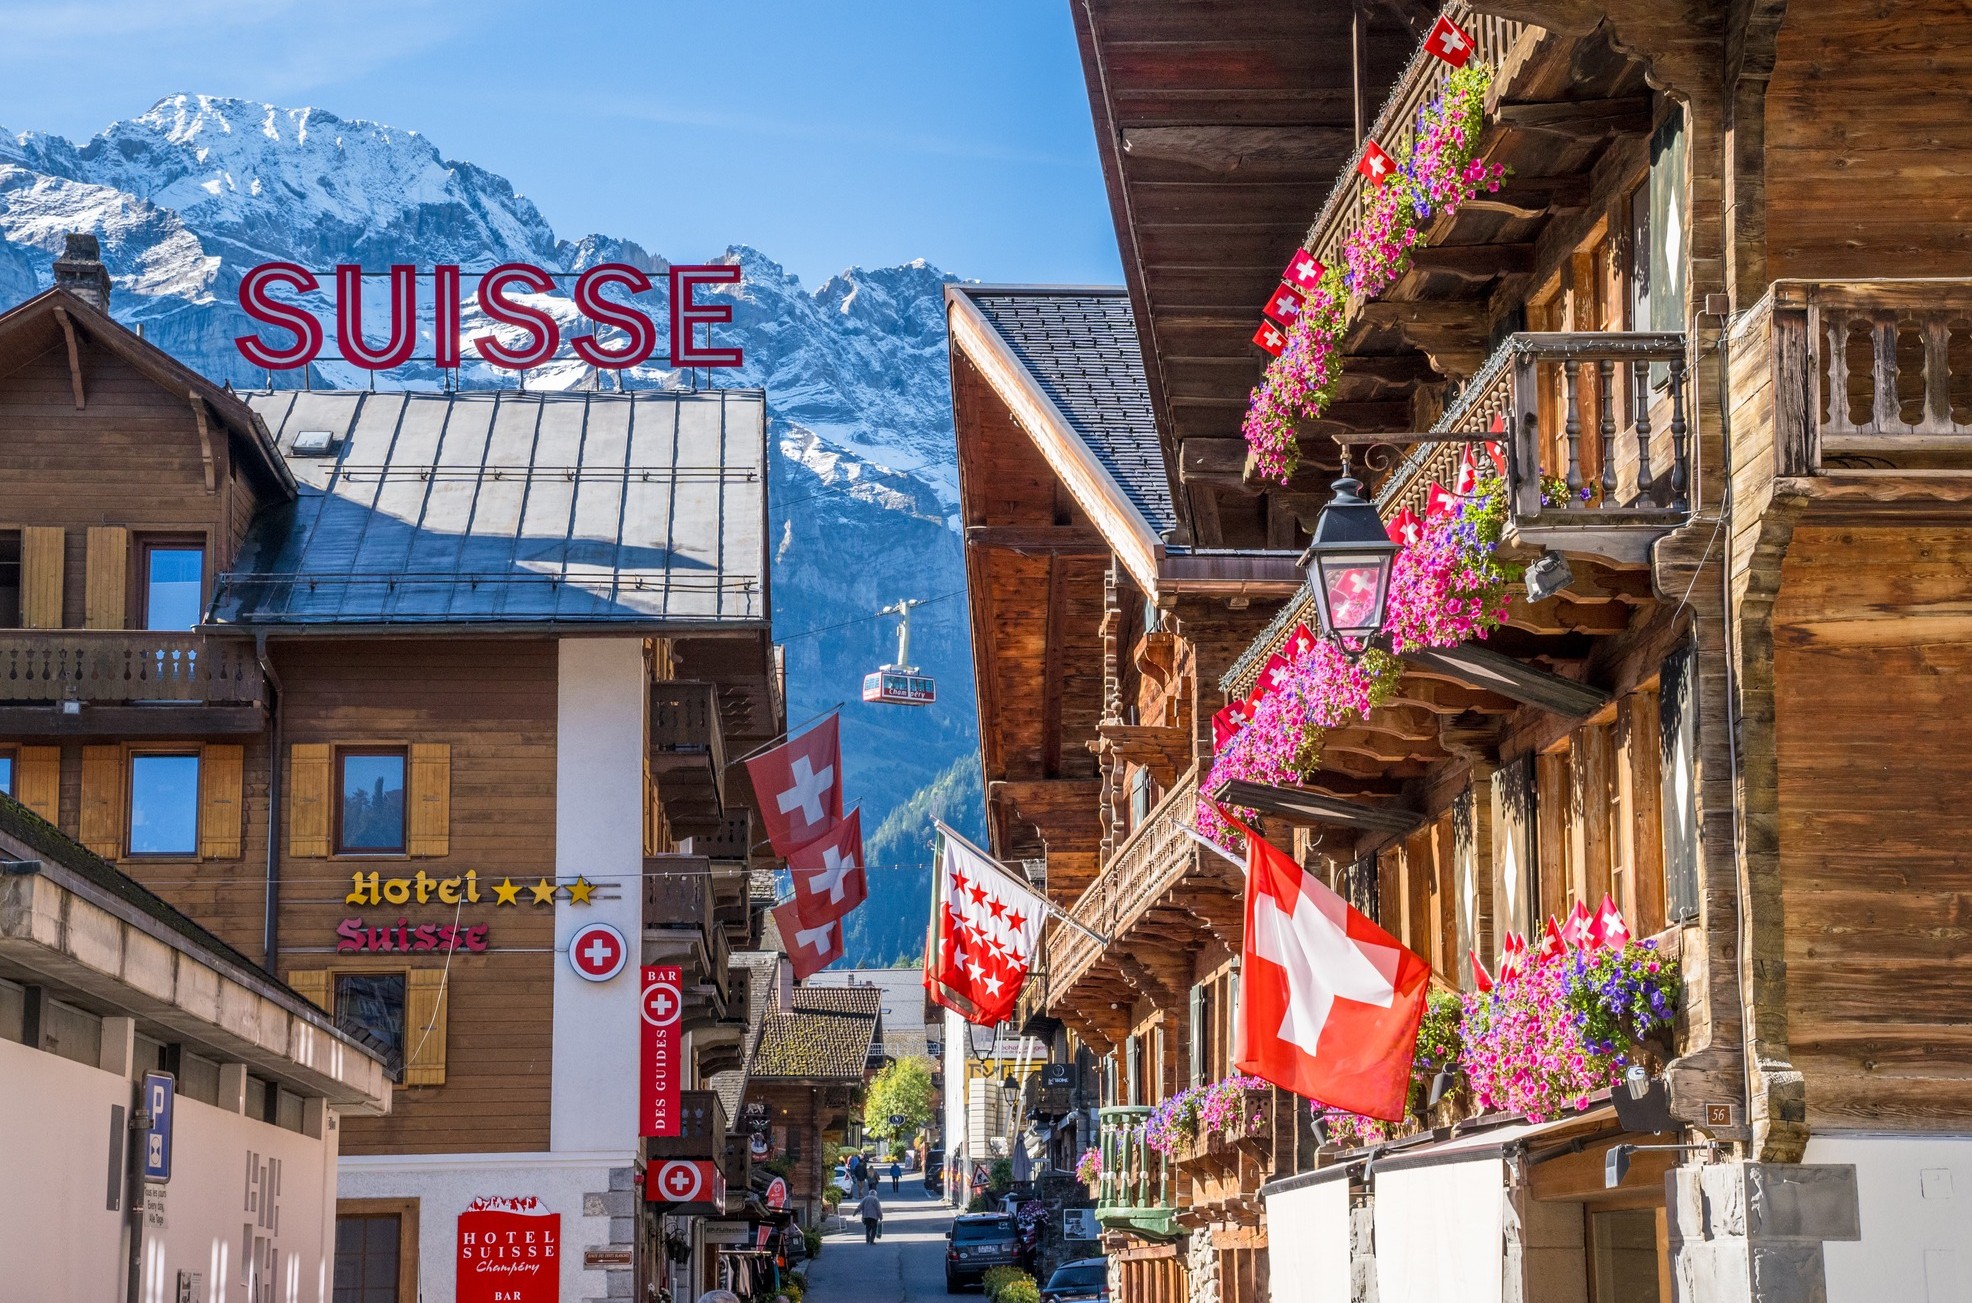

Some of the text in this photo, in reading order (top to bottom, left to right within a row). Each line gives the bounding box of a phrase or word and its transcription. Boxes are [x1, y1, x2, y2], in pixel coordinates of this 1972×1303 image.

[235, 262, 744, 370] SUISSE
[345, 869, 481, 906] Hotel
[335, 917, 490, 953] Suisse
[647, 971, 677, 982] BAR
[655, 1029, 667, 1130] DES GUIDES
[152, 1085, 165, 1130] P
[1711, 1108, 1726, 1121] 56
[463, 1231, 554, 1245] HOTEL
[463, 1245, 554, 1259] SUISSE
[475, 1259, 540, 1276] Champéry
[494, 1291, 521, 1301] BAR
